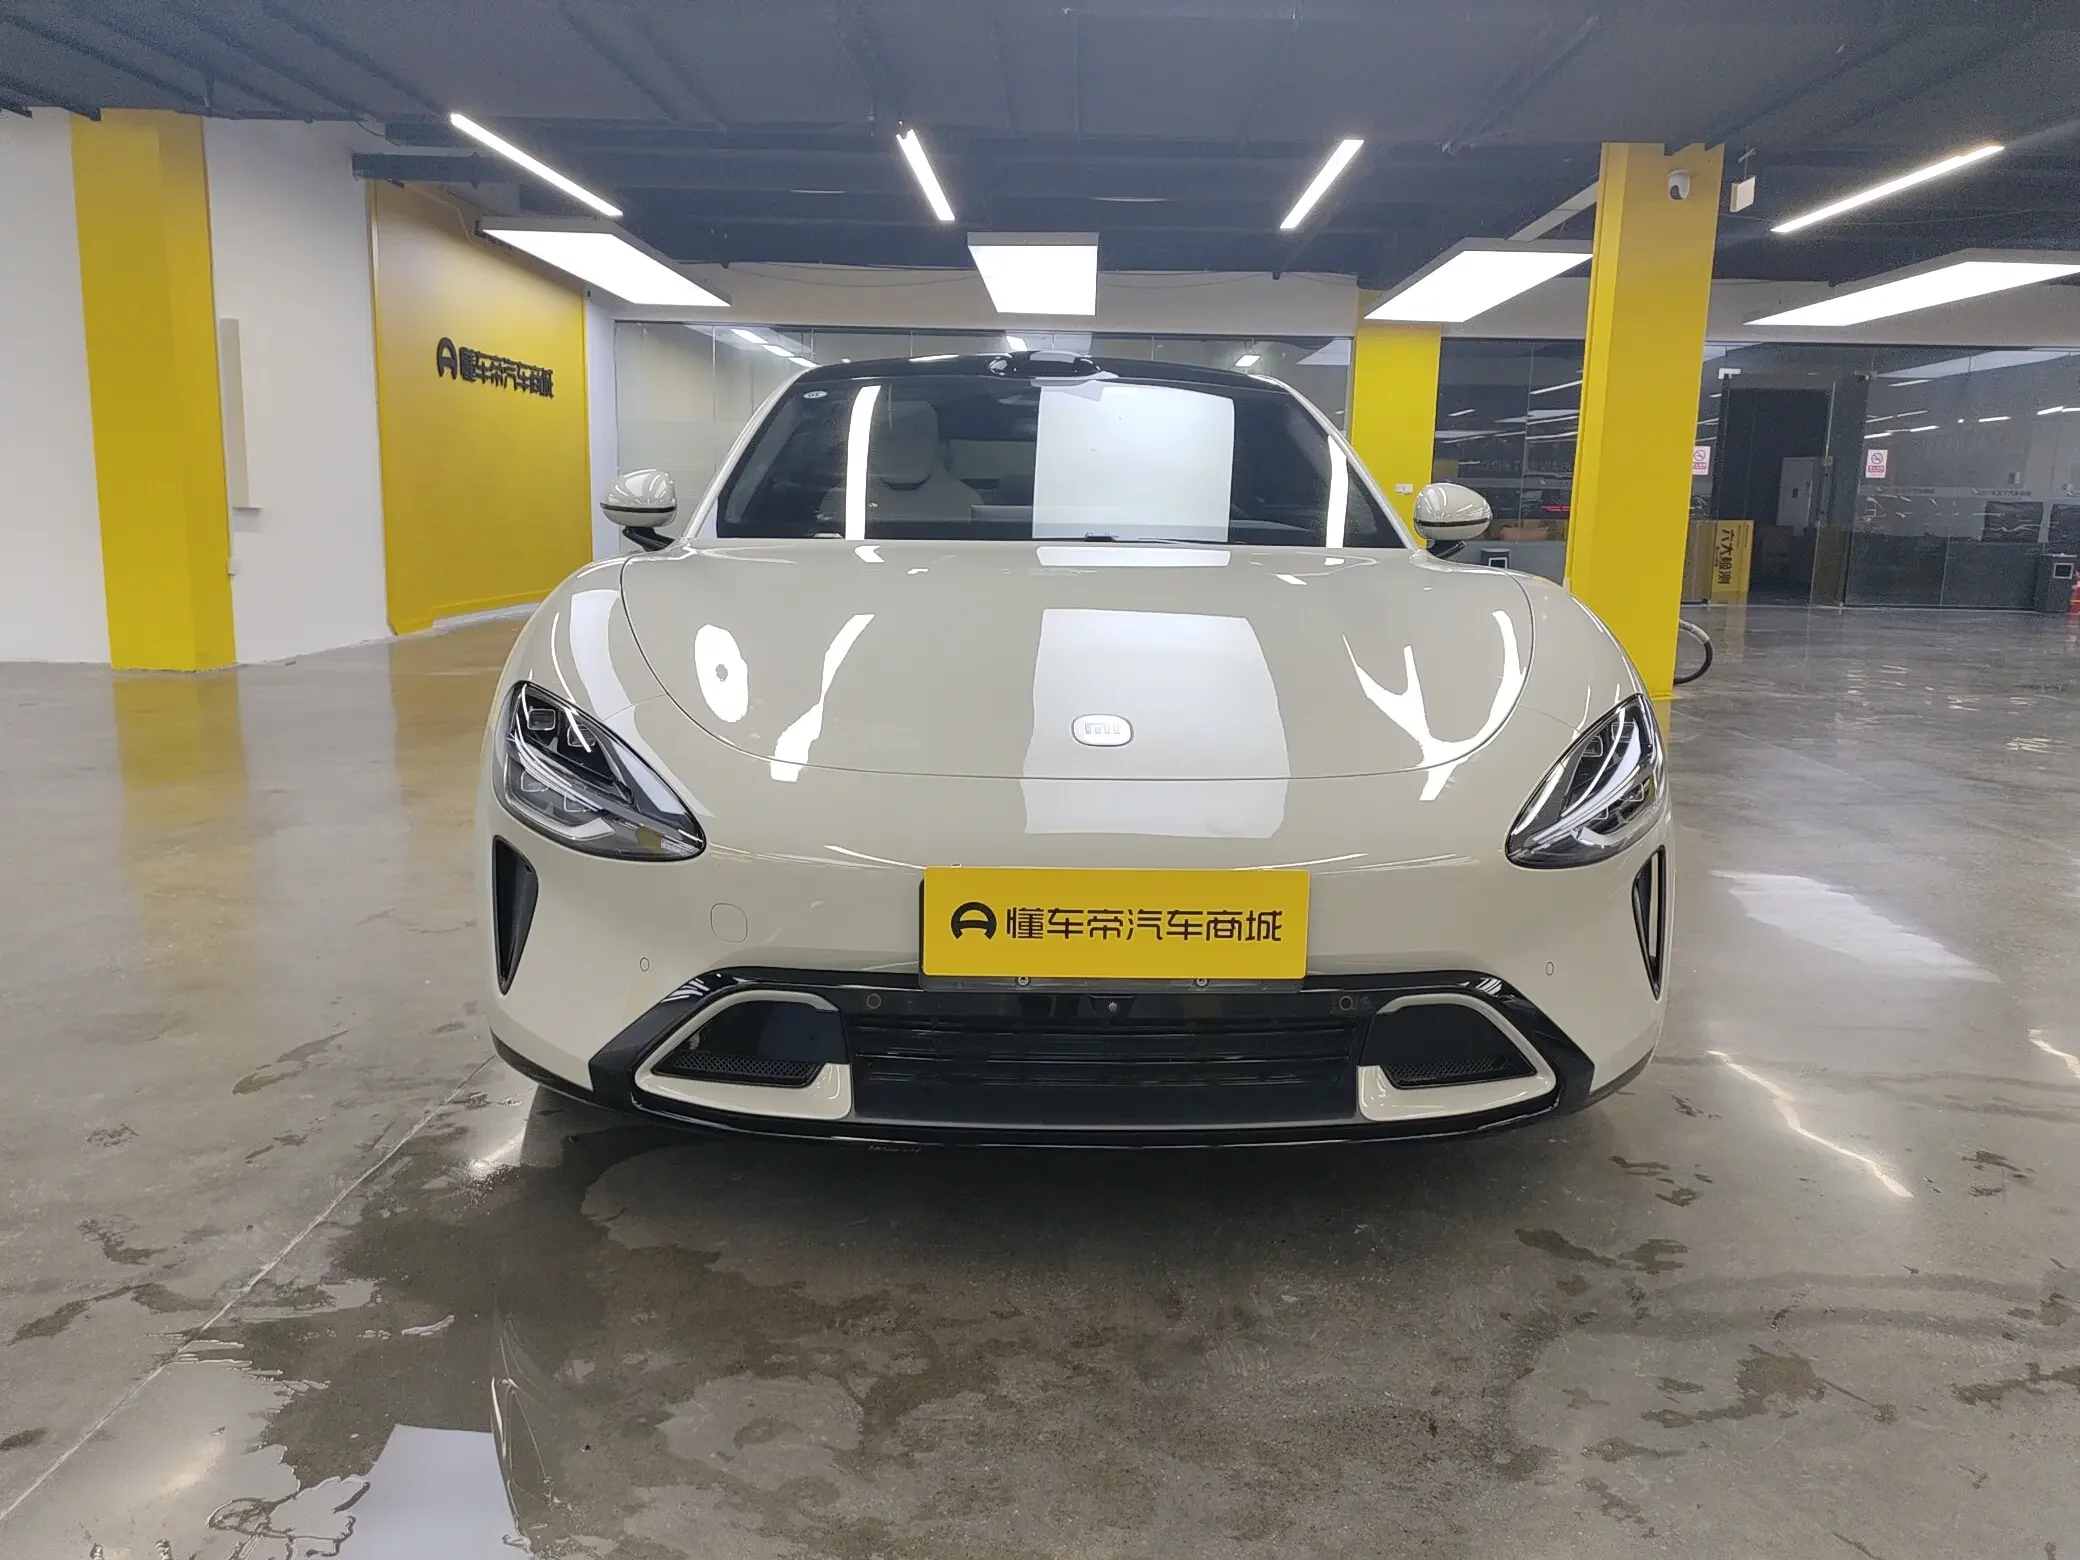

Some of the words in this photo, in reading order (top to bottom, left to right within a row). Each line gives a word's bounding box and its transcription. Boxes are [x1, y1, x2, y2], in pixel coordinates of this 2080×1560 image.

[1006, 906, 1283, 942] 懂车帝汽车商城
